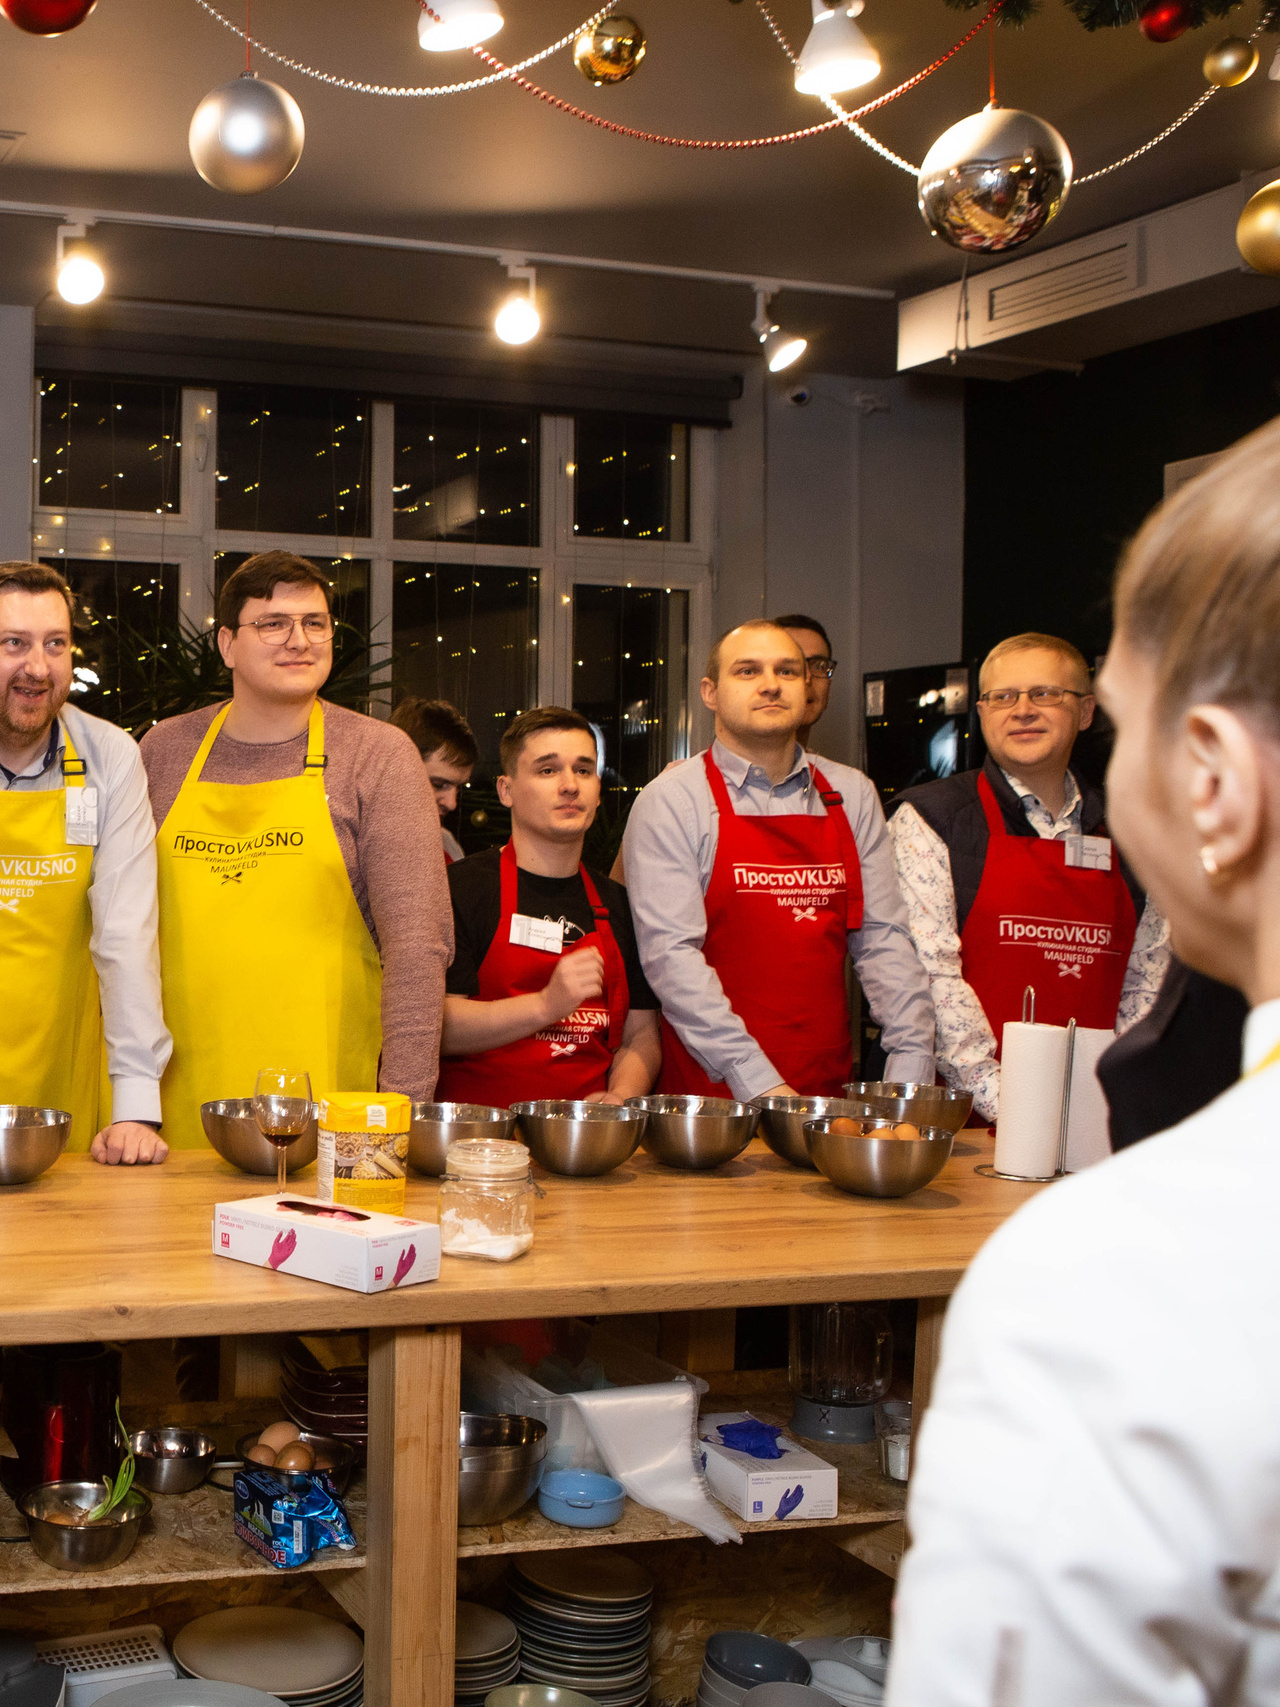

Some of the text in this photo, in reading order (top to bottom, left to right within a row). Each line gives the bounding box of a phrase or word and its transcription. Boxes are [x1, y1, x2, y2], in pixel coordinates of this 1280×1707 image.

[173, 831, 304, 854] ПростоVKUSNO
[210, 860, 258, 873] MAUNFELD
[16, 878, 43, 886] СТУДИЯ
[733, 867, 847, 888] ПростоVKUSN
[769, 888, 836, 896] КУЛИНАРНАЯ СТУДИЯ
[776, 896, 829, 907] MAUNFELD
[998, 919, 1112, 946] ПростоVKUSN
[1044, 951, 1095, 964] MAUNFELD
[535, 1032, 590, 1044] MAUNFELD
[219, 1213, 230, 1221] PINK
[219, 1220, 235, 1229] POWDER
[222, 1233, 229, 1243] M
[376, 1267, 382, 1275] M
[234, 1520, 287, 1564] СЛИВОЧНОЕ
